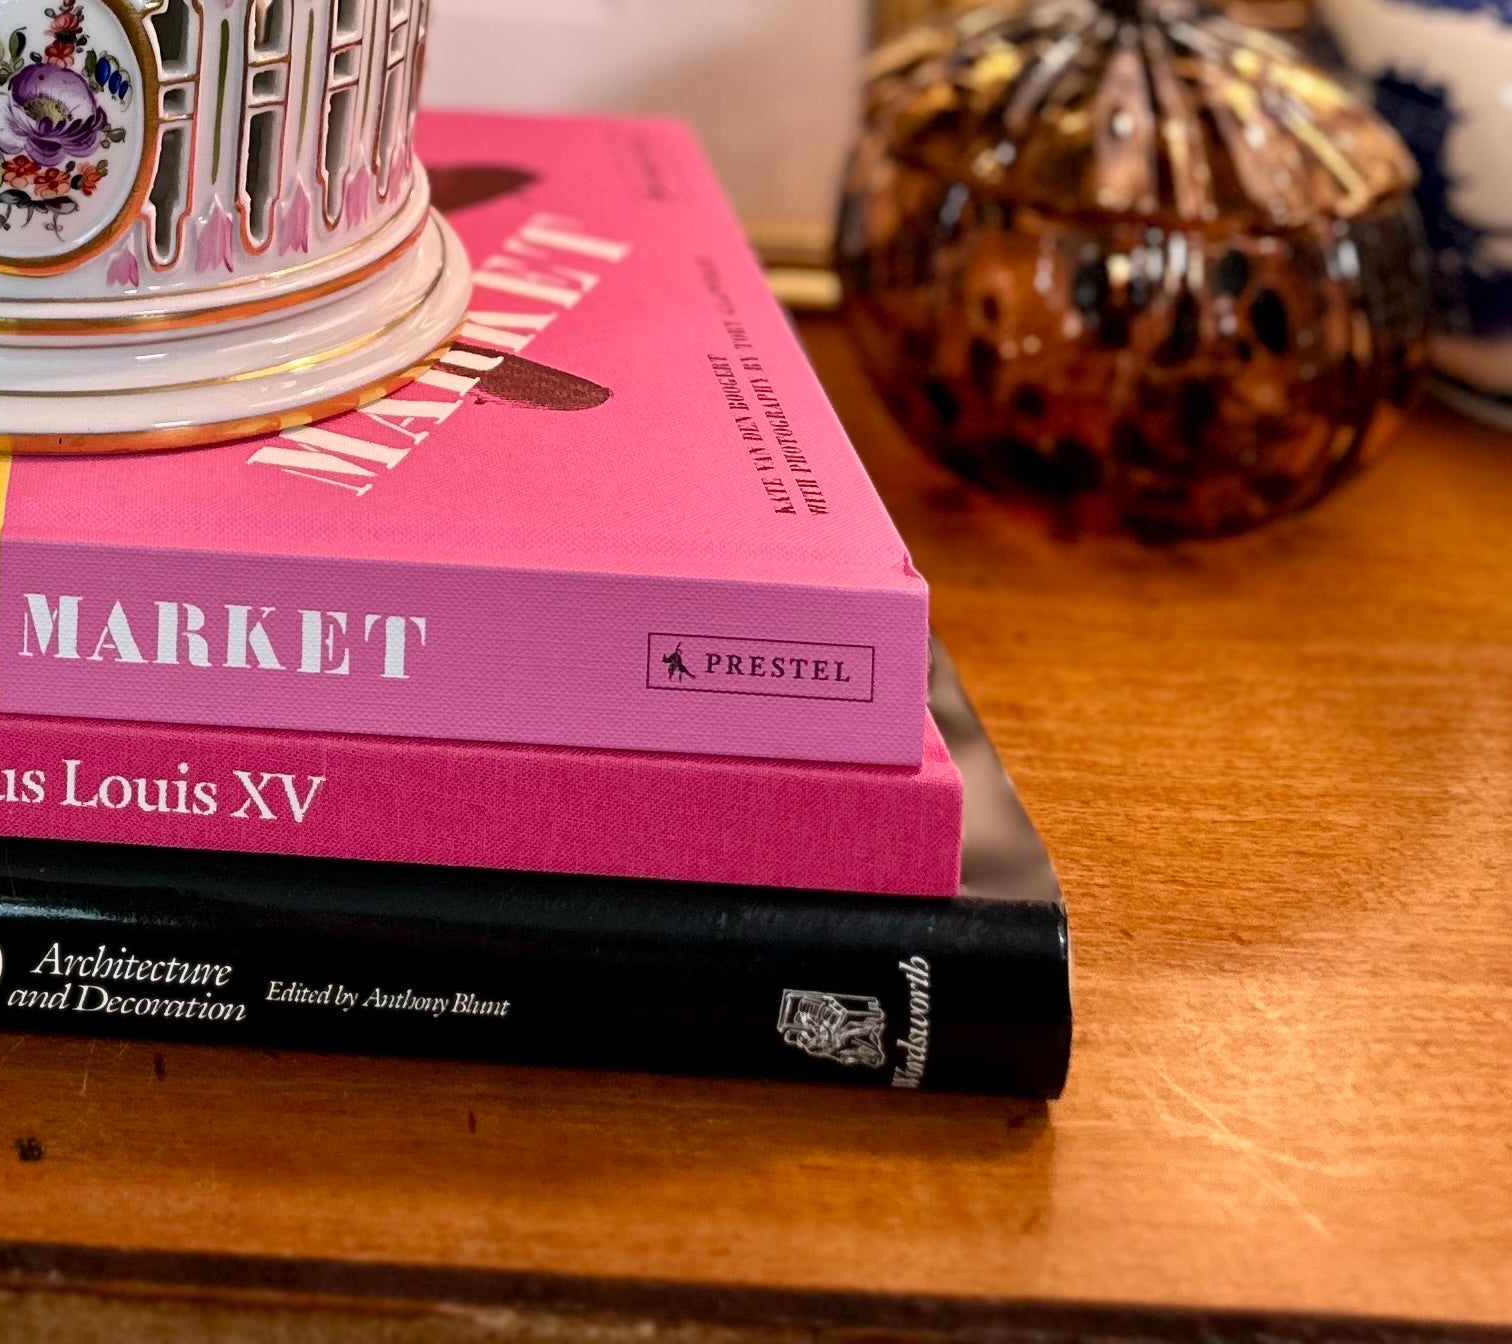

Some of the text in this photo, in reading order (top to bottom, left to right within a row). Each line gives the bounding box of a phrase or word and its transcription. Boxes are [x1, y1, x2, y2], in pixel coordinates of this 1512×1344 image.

[707, 353, 750, 411] BOOGERT
[739, 356, 763, 371] BY
[735, 416, 764, 441] DEN
[749, 375, 812, 473] PHOTOGRAPHY
[748, 447, 775, 472] VAN
[761, 477, 797, 514] KATE
[795, 478, 829, 516] WITH
[18, 592, 428, 681] MARKET
[705, 653, 850, 682] PRESTEL
[61, 759, 219, 815] Louis
[231, 769, 327, 823] XV
[29, 942, 233, 986] Architecture
[7, 983, 247, 1021] and Decoration
[265, 980, 511, 1018] Edited by Anthony Blunt
[891, 955, 930, 1089] Wordsworth
